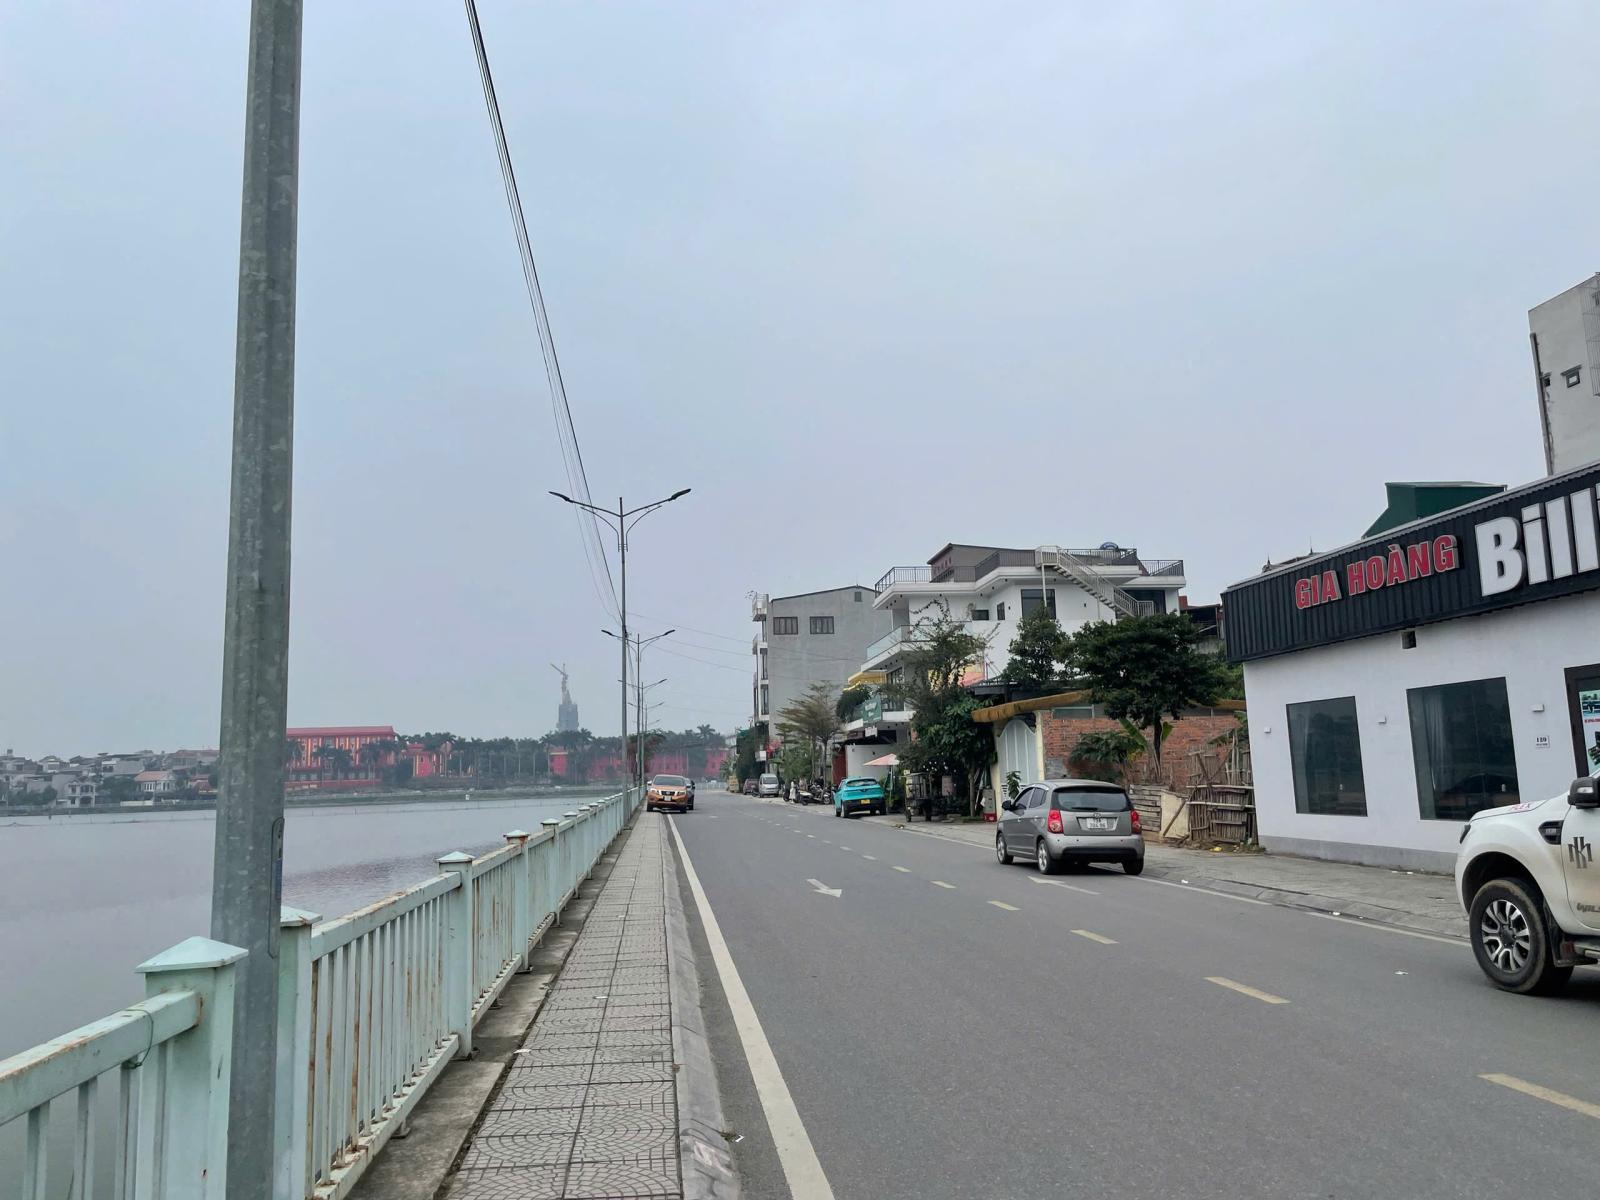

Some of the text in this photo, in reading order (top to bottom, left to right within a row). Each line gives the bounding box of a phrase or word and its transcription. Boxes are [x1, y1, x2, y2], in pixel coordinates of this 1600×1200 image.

[1295, 534, 1459, 610] GIA HOÀNG
[1475, 483, 1600, 597] Bill
